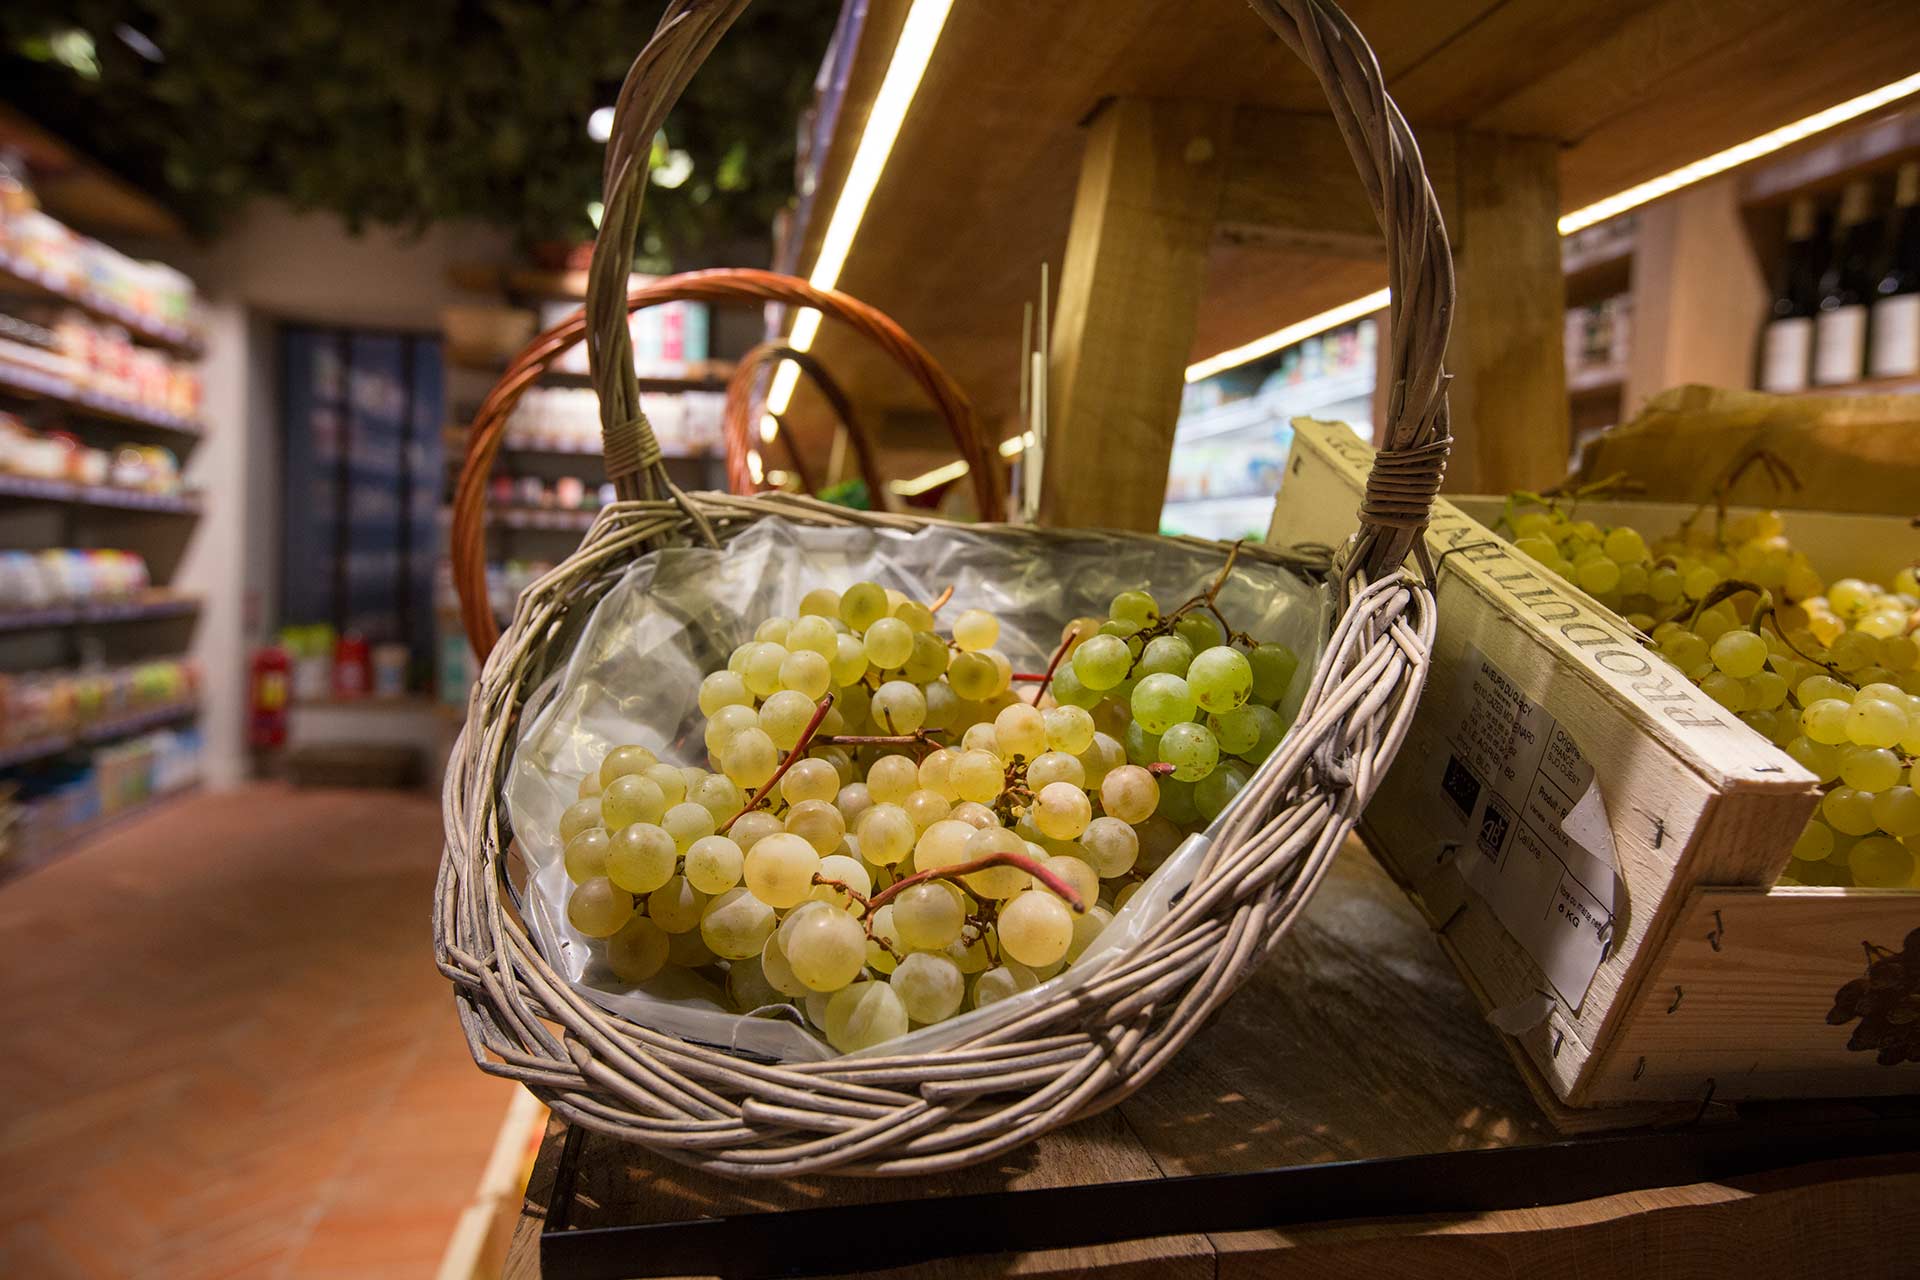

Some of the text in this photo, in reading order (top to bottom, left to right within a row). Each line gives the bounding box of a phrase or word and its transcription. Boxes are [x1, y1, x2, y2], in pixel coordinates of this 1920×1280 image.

[1483, 568, 1731, 730] PRODUIT
[1551, 742, 1575, 769] FRANCE
[1504, 766, 1516, 781] 82
[1565, 909, 1580, 928] KG
